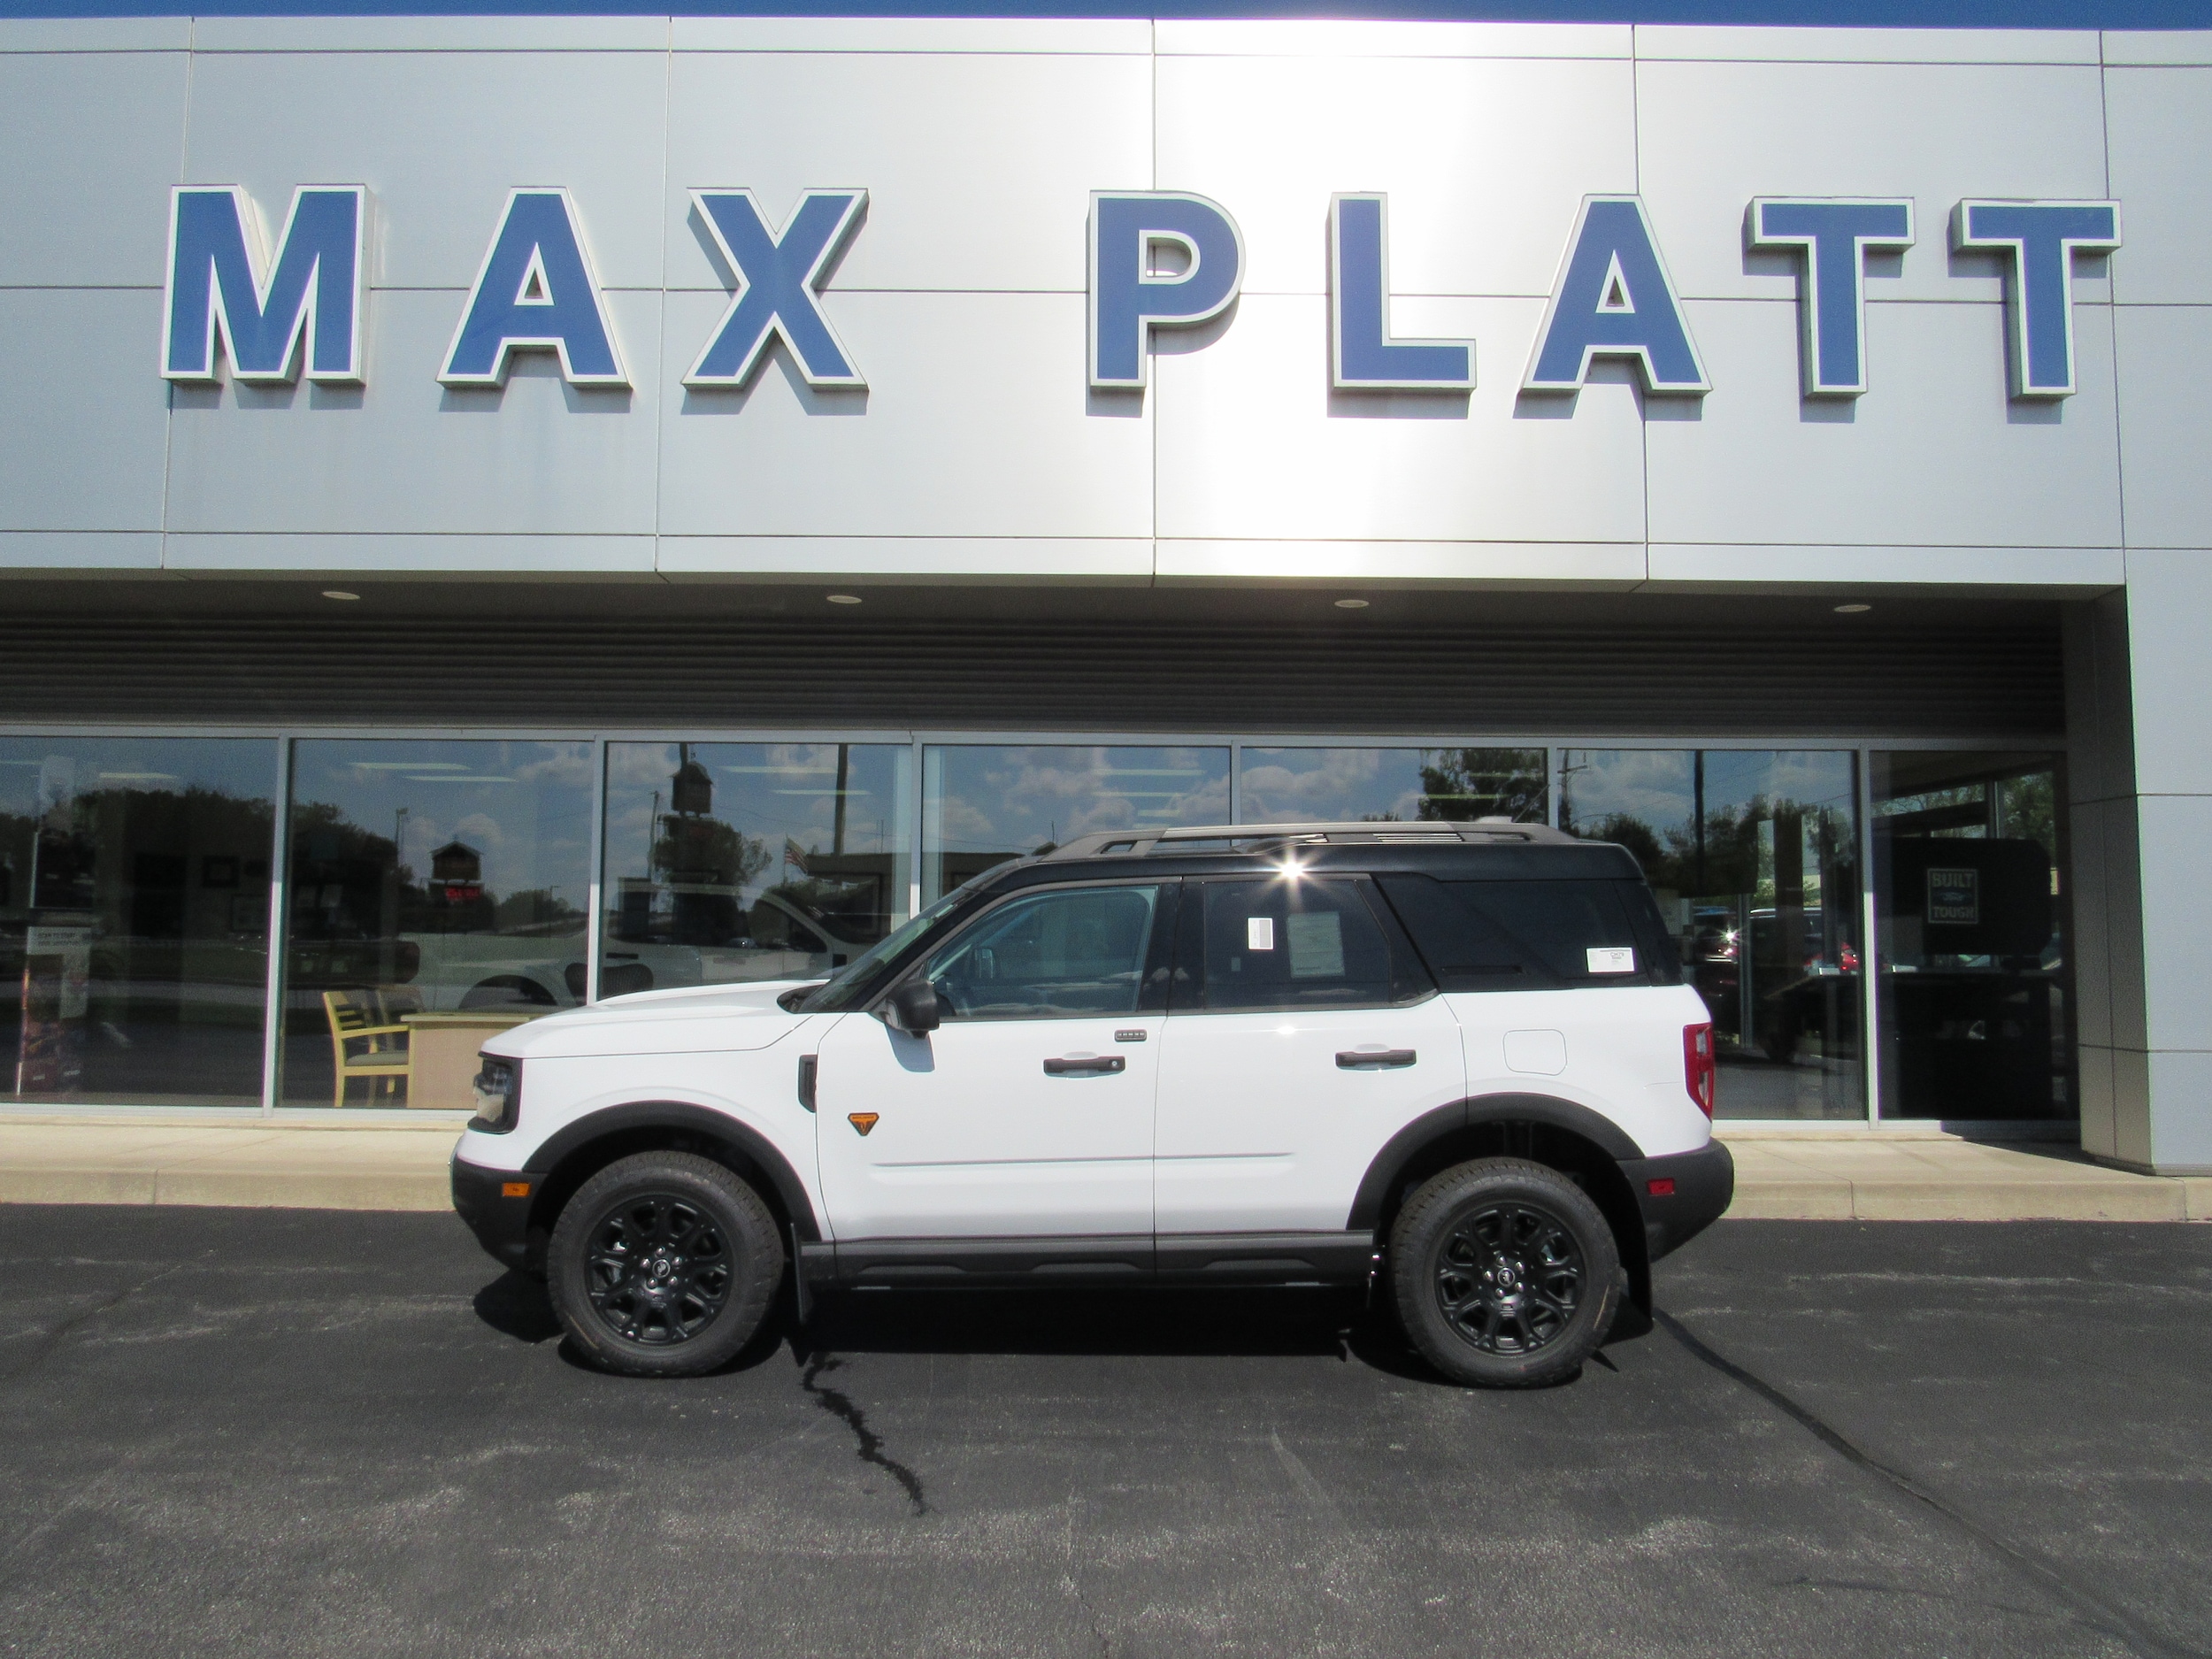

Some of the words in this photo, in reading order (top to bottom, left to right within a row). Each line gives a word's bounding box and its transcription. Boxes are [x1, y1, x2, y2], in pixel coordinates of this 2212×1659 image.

[160, 184, 869, 390] MAX
[1088, 189, 2123, 399] PLATT
[1932, 872, 1973, 887] BUILT
[1932, 906, 1974, 918] TOUGH
